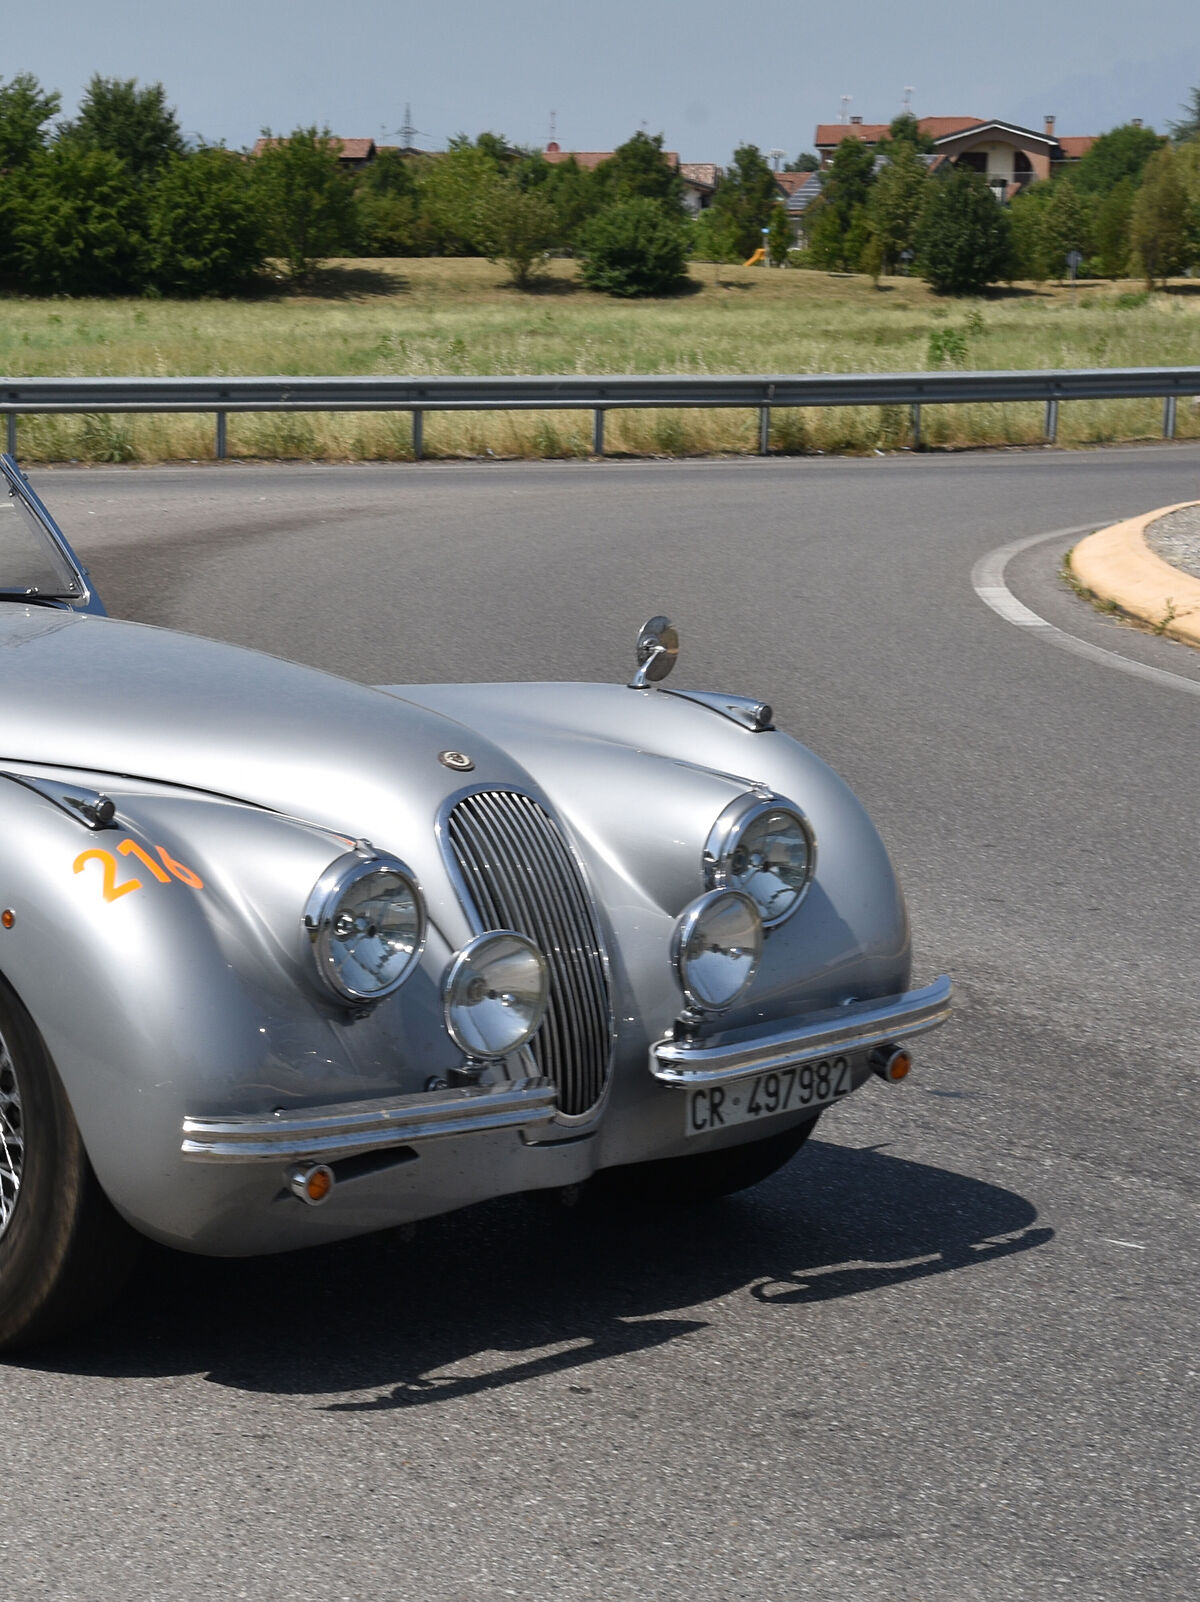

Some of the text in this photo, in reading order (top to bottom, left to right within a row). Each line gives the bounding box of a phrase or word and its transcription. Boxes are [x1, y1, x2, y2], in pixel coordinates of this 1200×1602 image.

[73, 838, 204, 904] 216
[690, 1056, 849, 1130] CR 497982
